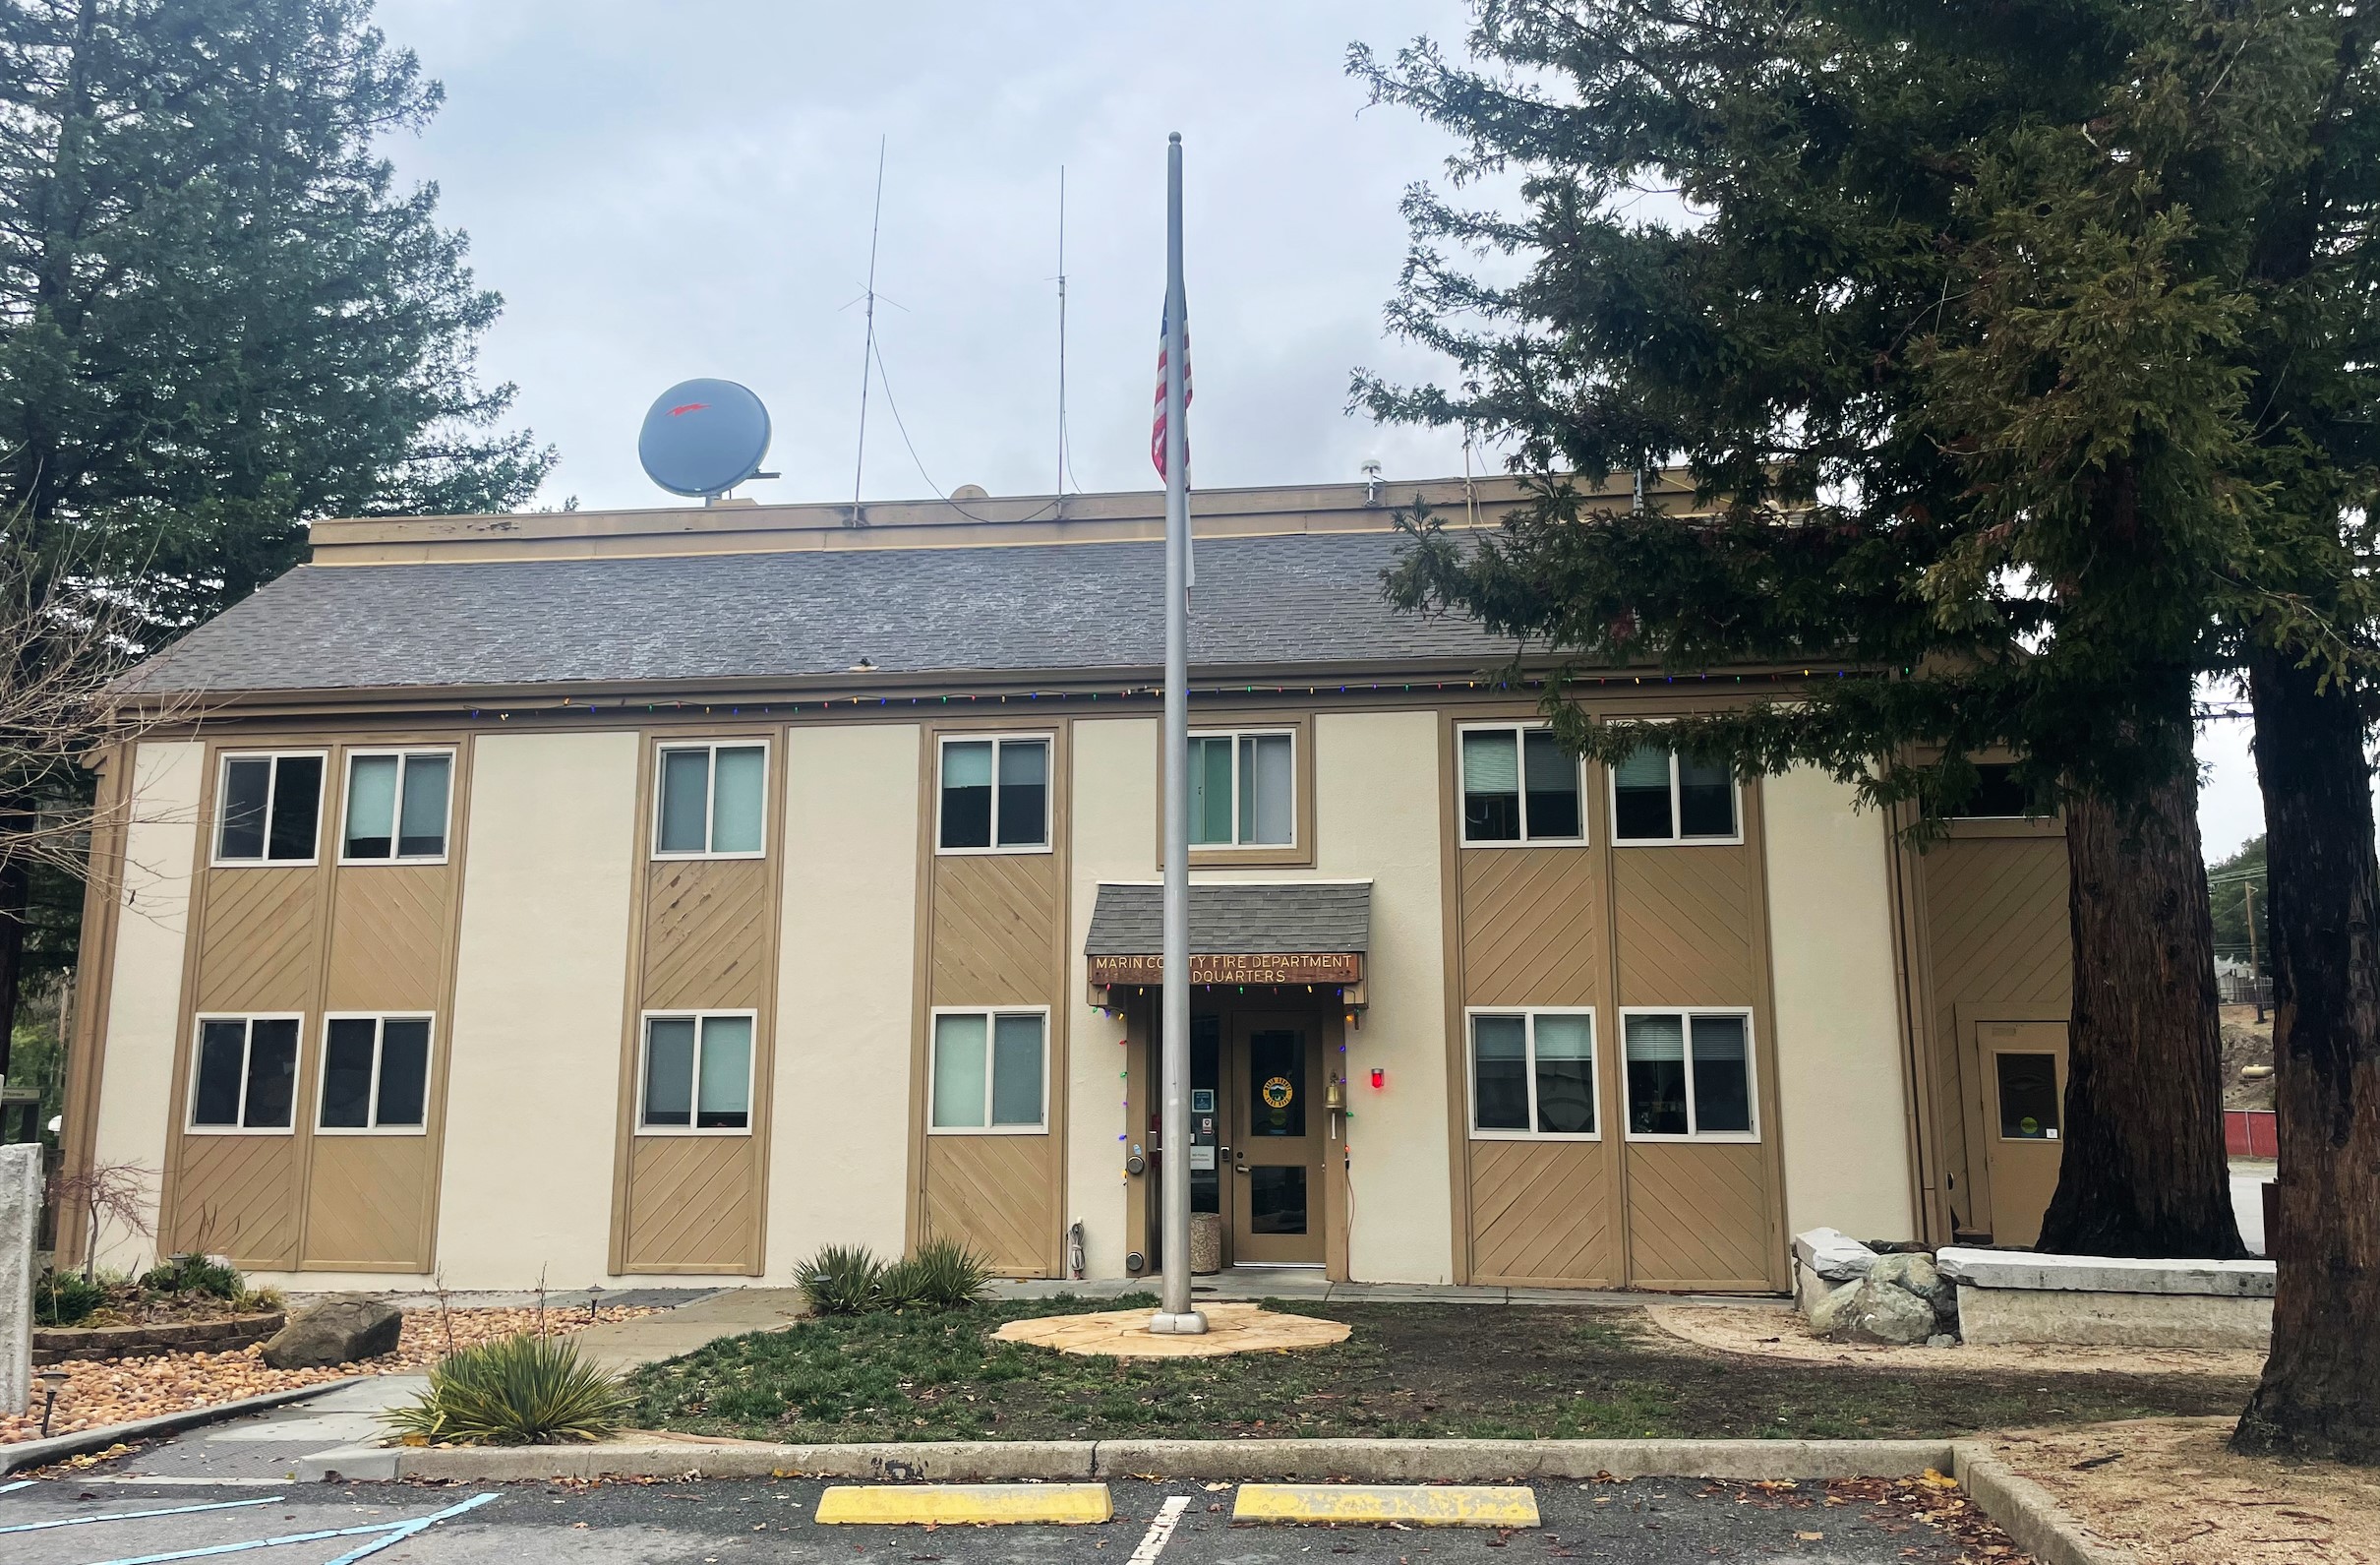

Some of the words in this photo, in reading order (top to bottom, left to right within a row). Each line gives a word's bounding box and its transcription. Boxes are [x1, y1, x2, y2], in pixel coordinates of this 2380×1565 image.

[1096, 957, 1142, 969] MARIN
[1147, 957, 1206, 969] COTY
[1213, 956, 1246, 969] FIRE
[1252, 955, 1351, 968] DEPARTMENT
[1189, 970, 1285, 983] DQUARTERS
